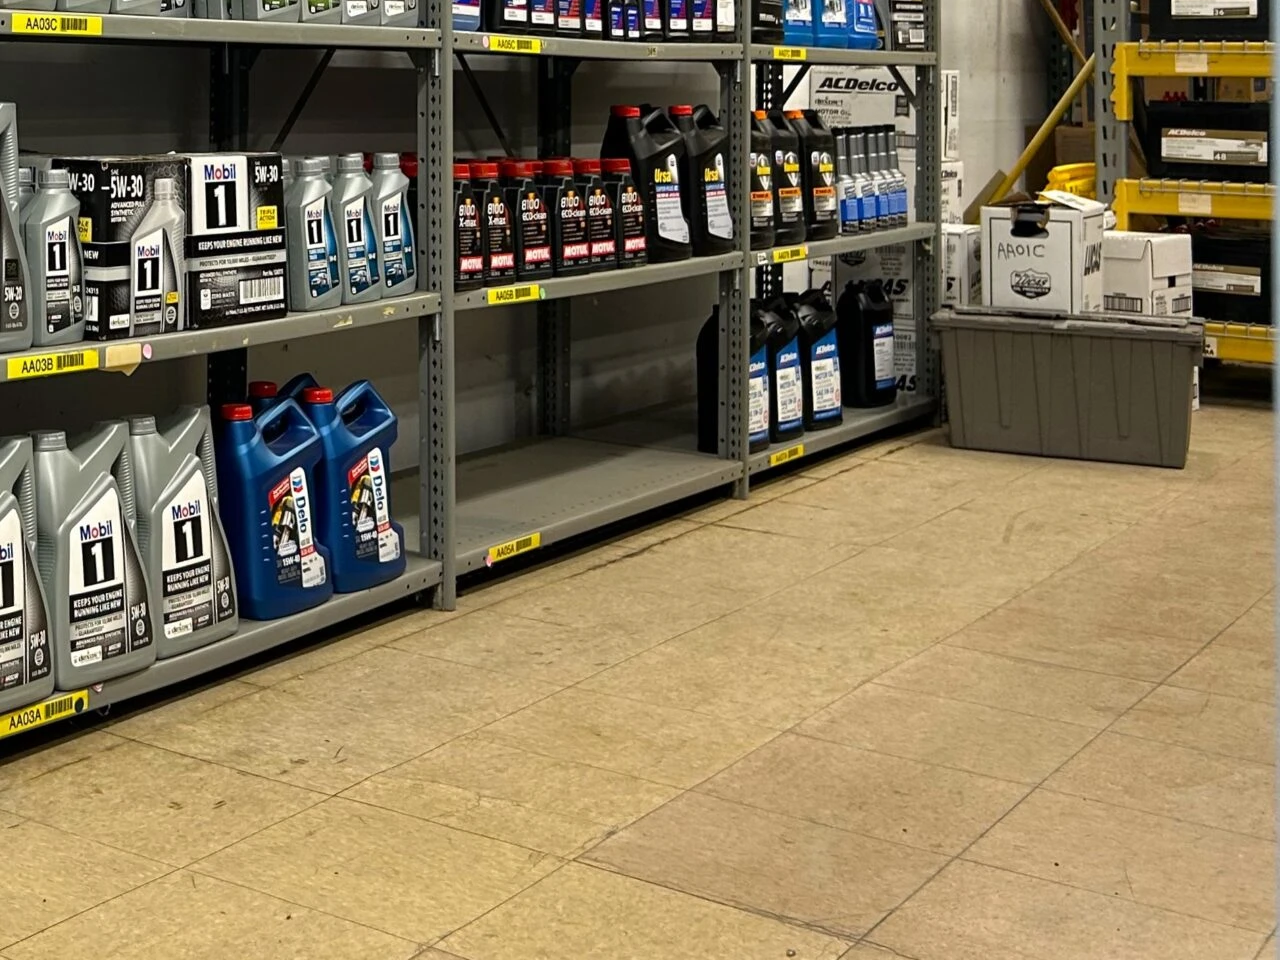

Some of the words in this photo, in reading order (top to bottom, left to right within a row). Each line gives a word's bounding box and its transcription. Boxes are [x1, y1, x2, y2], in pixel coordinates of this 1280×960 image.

[26, 18, 58, 31] AA03C
[497, 40, 516, 50] AA05C
[820, 77, 900, 92] ACDelco
[204, 164, 236, 181] Mobil
[255, 165, 278, 183] 5W-30
[654, 168, 672, 183] Ursa
[705, 168, 720, 182] Ursa
[111, 175, 143, 199] 5W-30
[459, 204, 476, 217] 8100
[521, 199, 540, 211] 8100
[459, 217, 478, 228] X-max
[625, 238, 646, 251] MOTUL
[525, 248, 550, 262] MOTUL
[461, 257, 483, 270] MOTUL
[4, 286, 23, 301] 5W-20
[495, 290, 514, 301] AA05B
[22, 358, 53, 373] AA03B
[374, 475, 384, 511] Delo
[296, 496, 307, 534] Delo
[80, 520, 112, 541] Mobil
[496, 544, 515, 558] AA05A
[30, 631, 46, 650] 5W-30
[8, 708, 42, 730] AA03A
